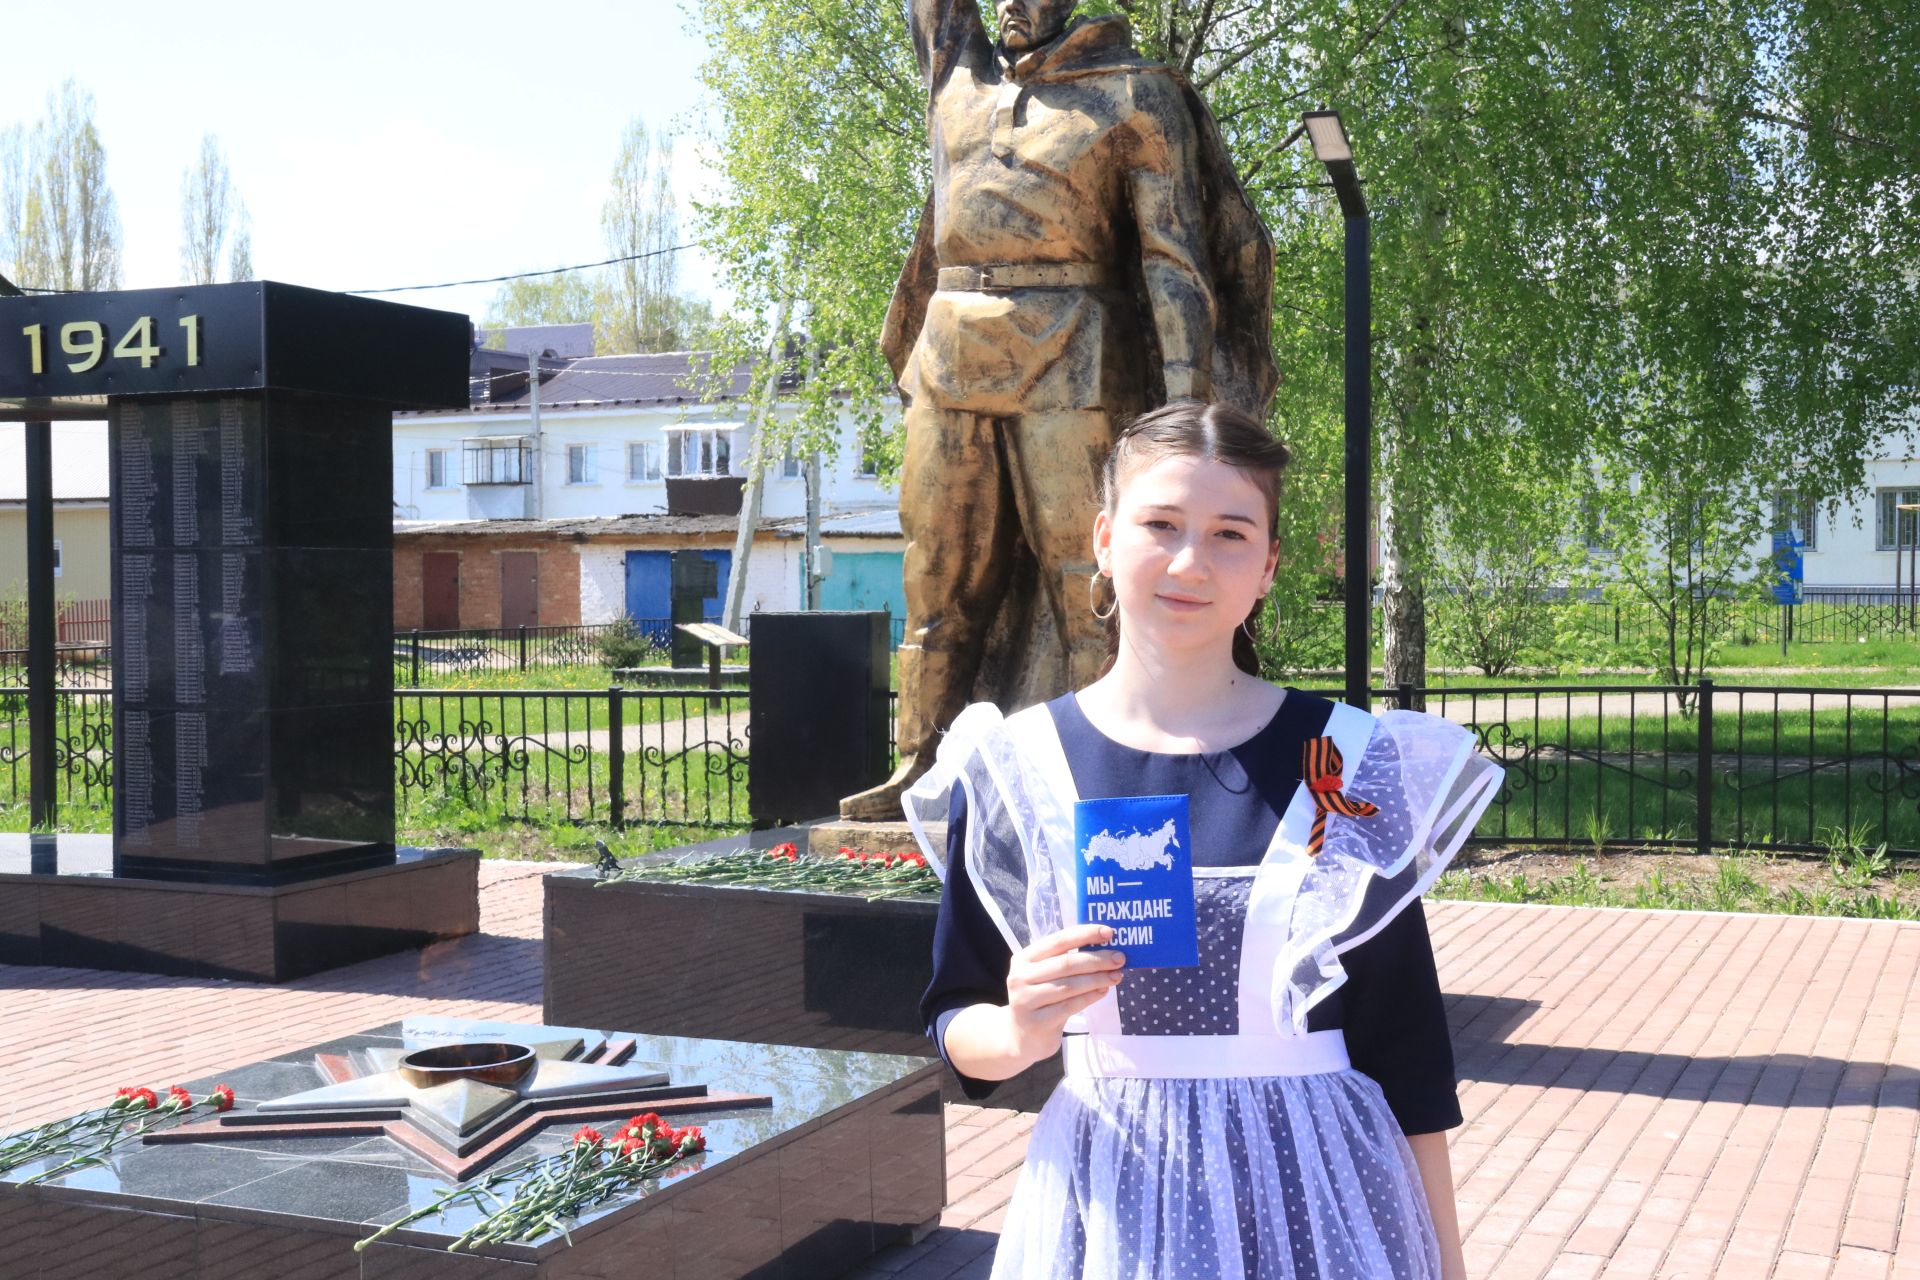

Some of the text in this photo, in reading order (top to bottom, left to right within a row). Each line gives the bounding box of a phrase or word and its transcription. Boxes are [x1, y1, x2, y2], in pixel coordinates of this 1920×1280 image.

[22, 314, 199, 374] 1941
[1086, 875, 1114, 896] МЫ
[1088, 898, 1173, 922] ГРАЖДАНЕ
[1090, 925, 1153, 947] ССИИ!
